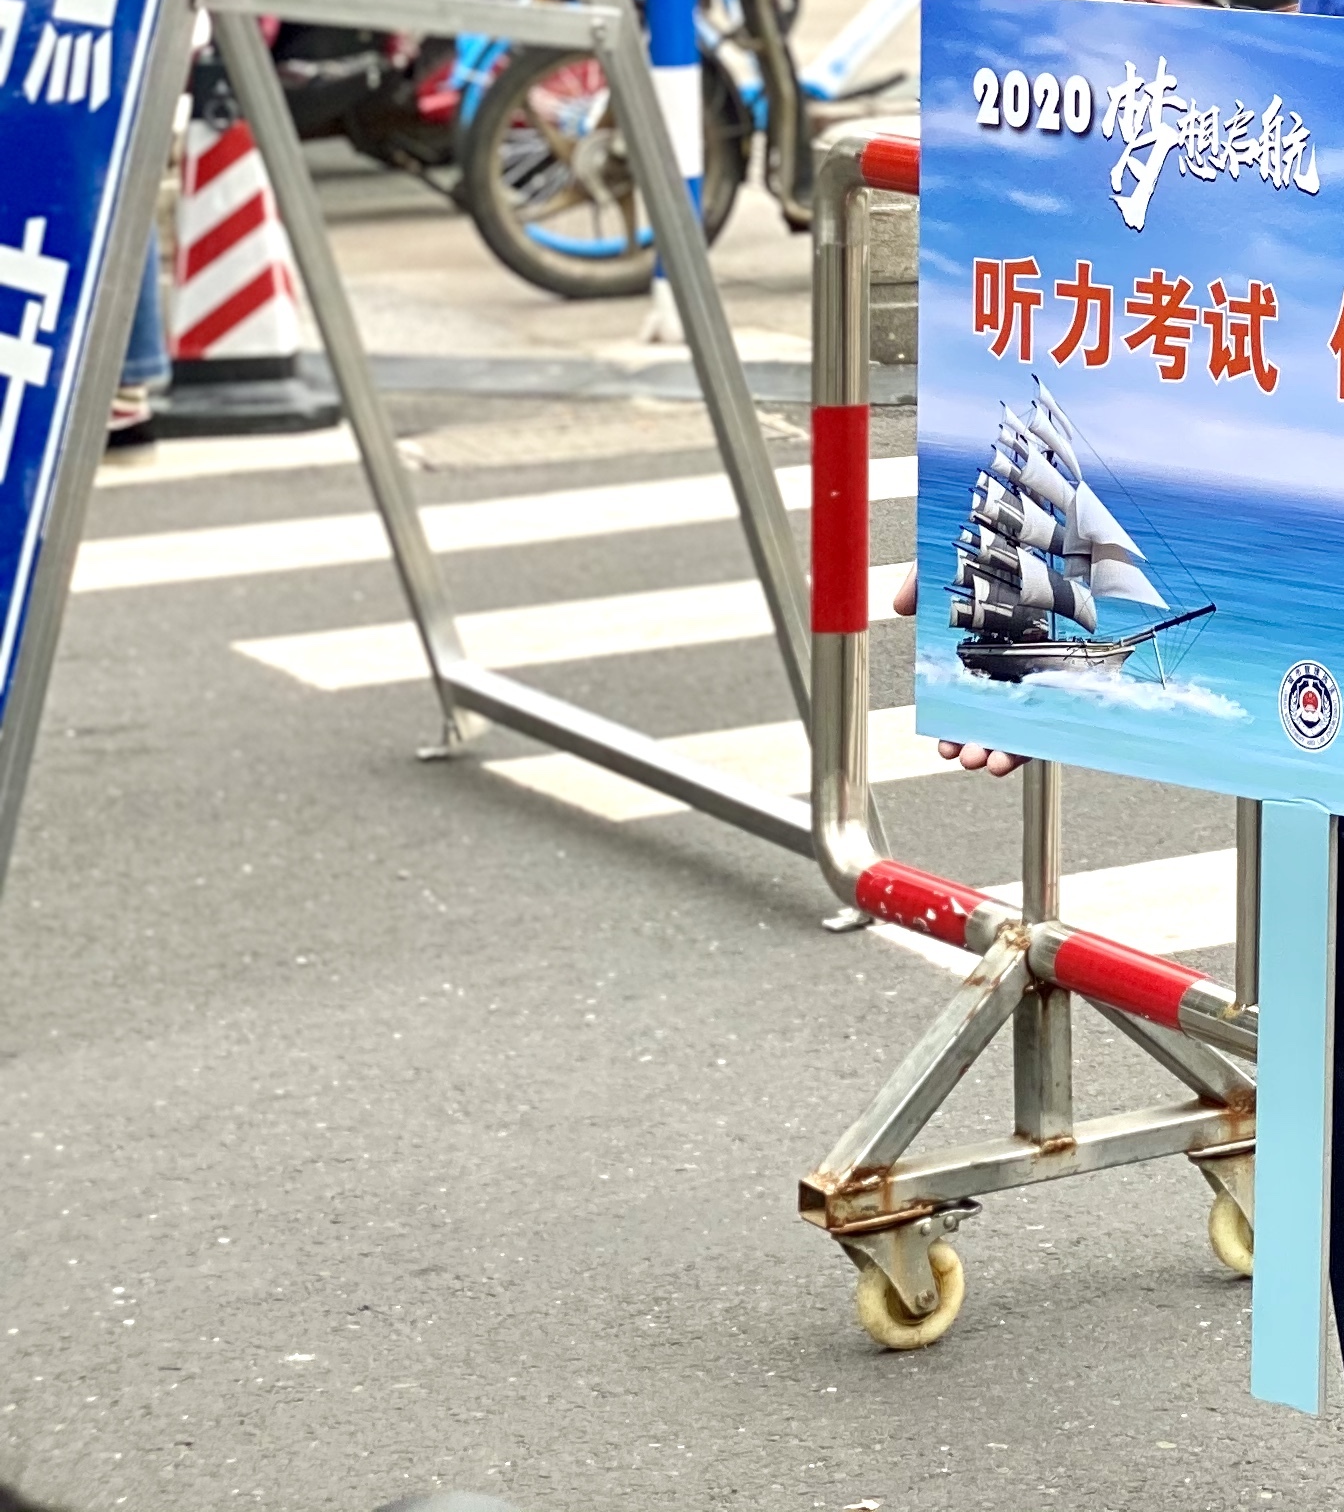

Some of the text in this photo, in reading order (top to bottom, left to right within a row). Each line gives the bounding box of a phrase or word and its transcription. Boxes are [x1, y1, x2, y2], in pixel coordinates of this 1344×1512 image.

[973, 67, 1093, 134] 2020
[972, 255, 1280, 395] 听力考试
